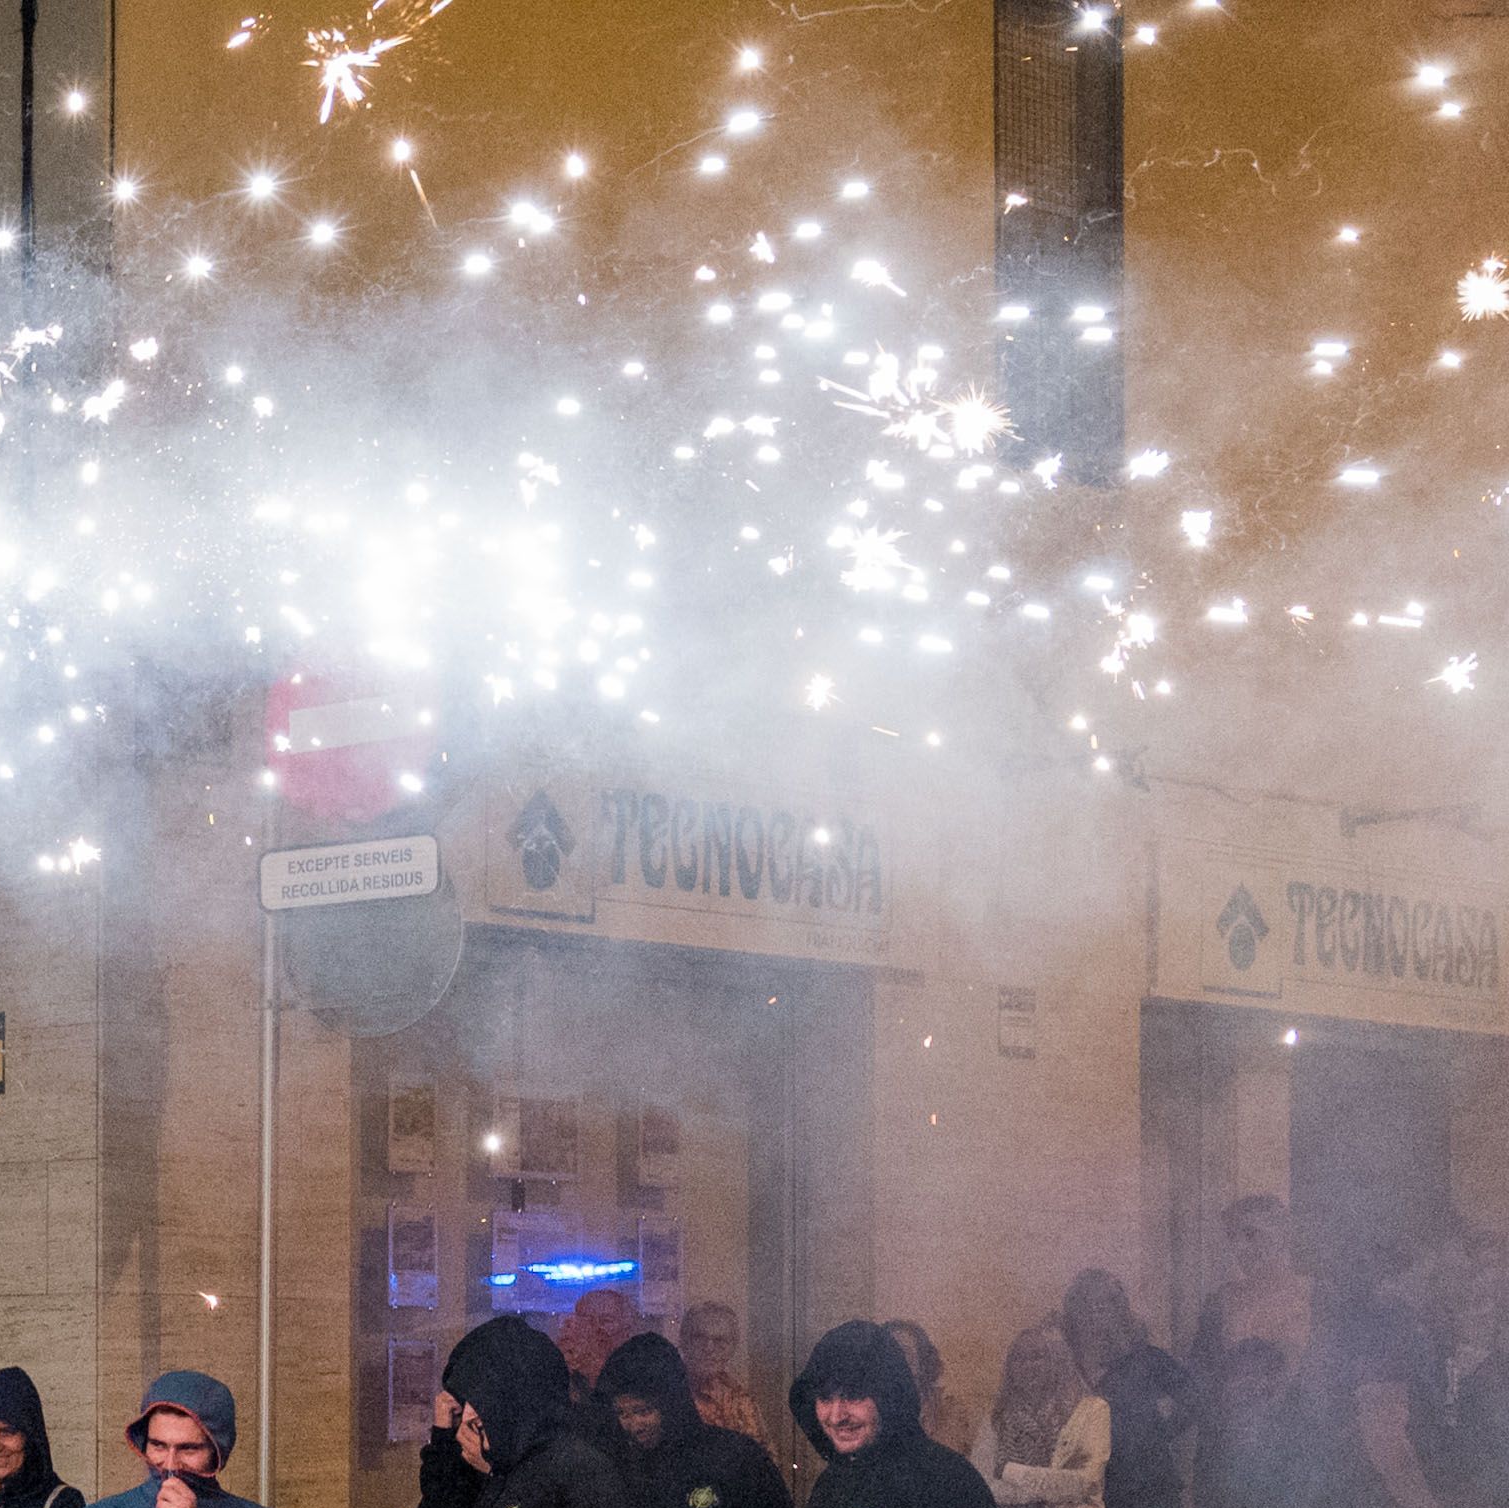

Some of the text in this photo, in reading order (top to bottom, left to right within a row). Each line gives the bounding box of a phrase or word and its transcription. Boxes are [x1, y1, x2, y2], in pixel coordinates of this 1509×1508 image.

[287, 848, 413, 875] EXCEPTE SERVEIS
[282, 871, 423, 899] RECOLLIDA RESIDUS
[1286, 880, 1499, 989] TECNOCASA
